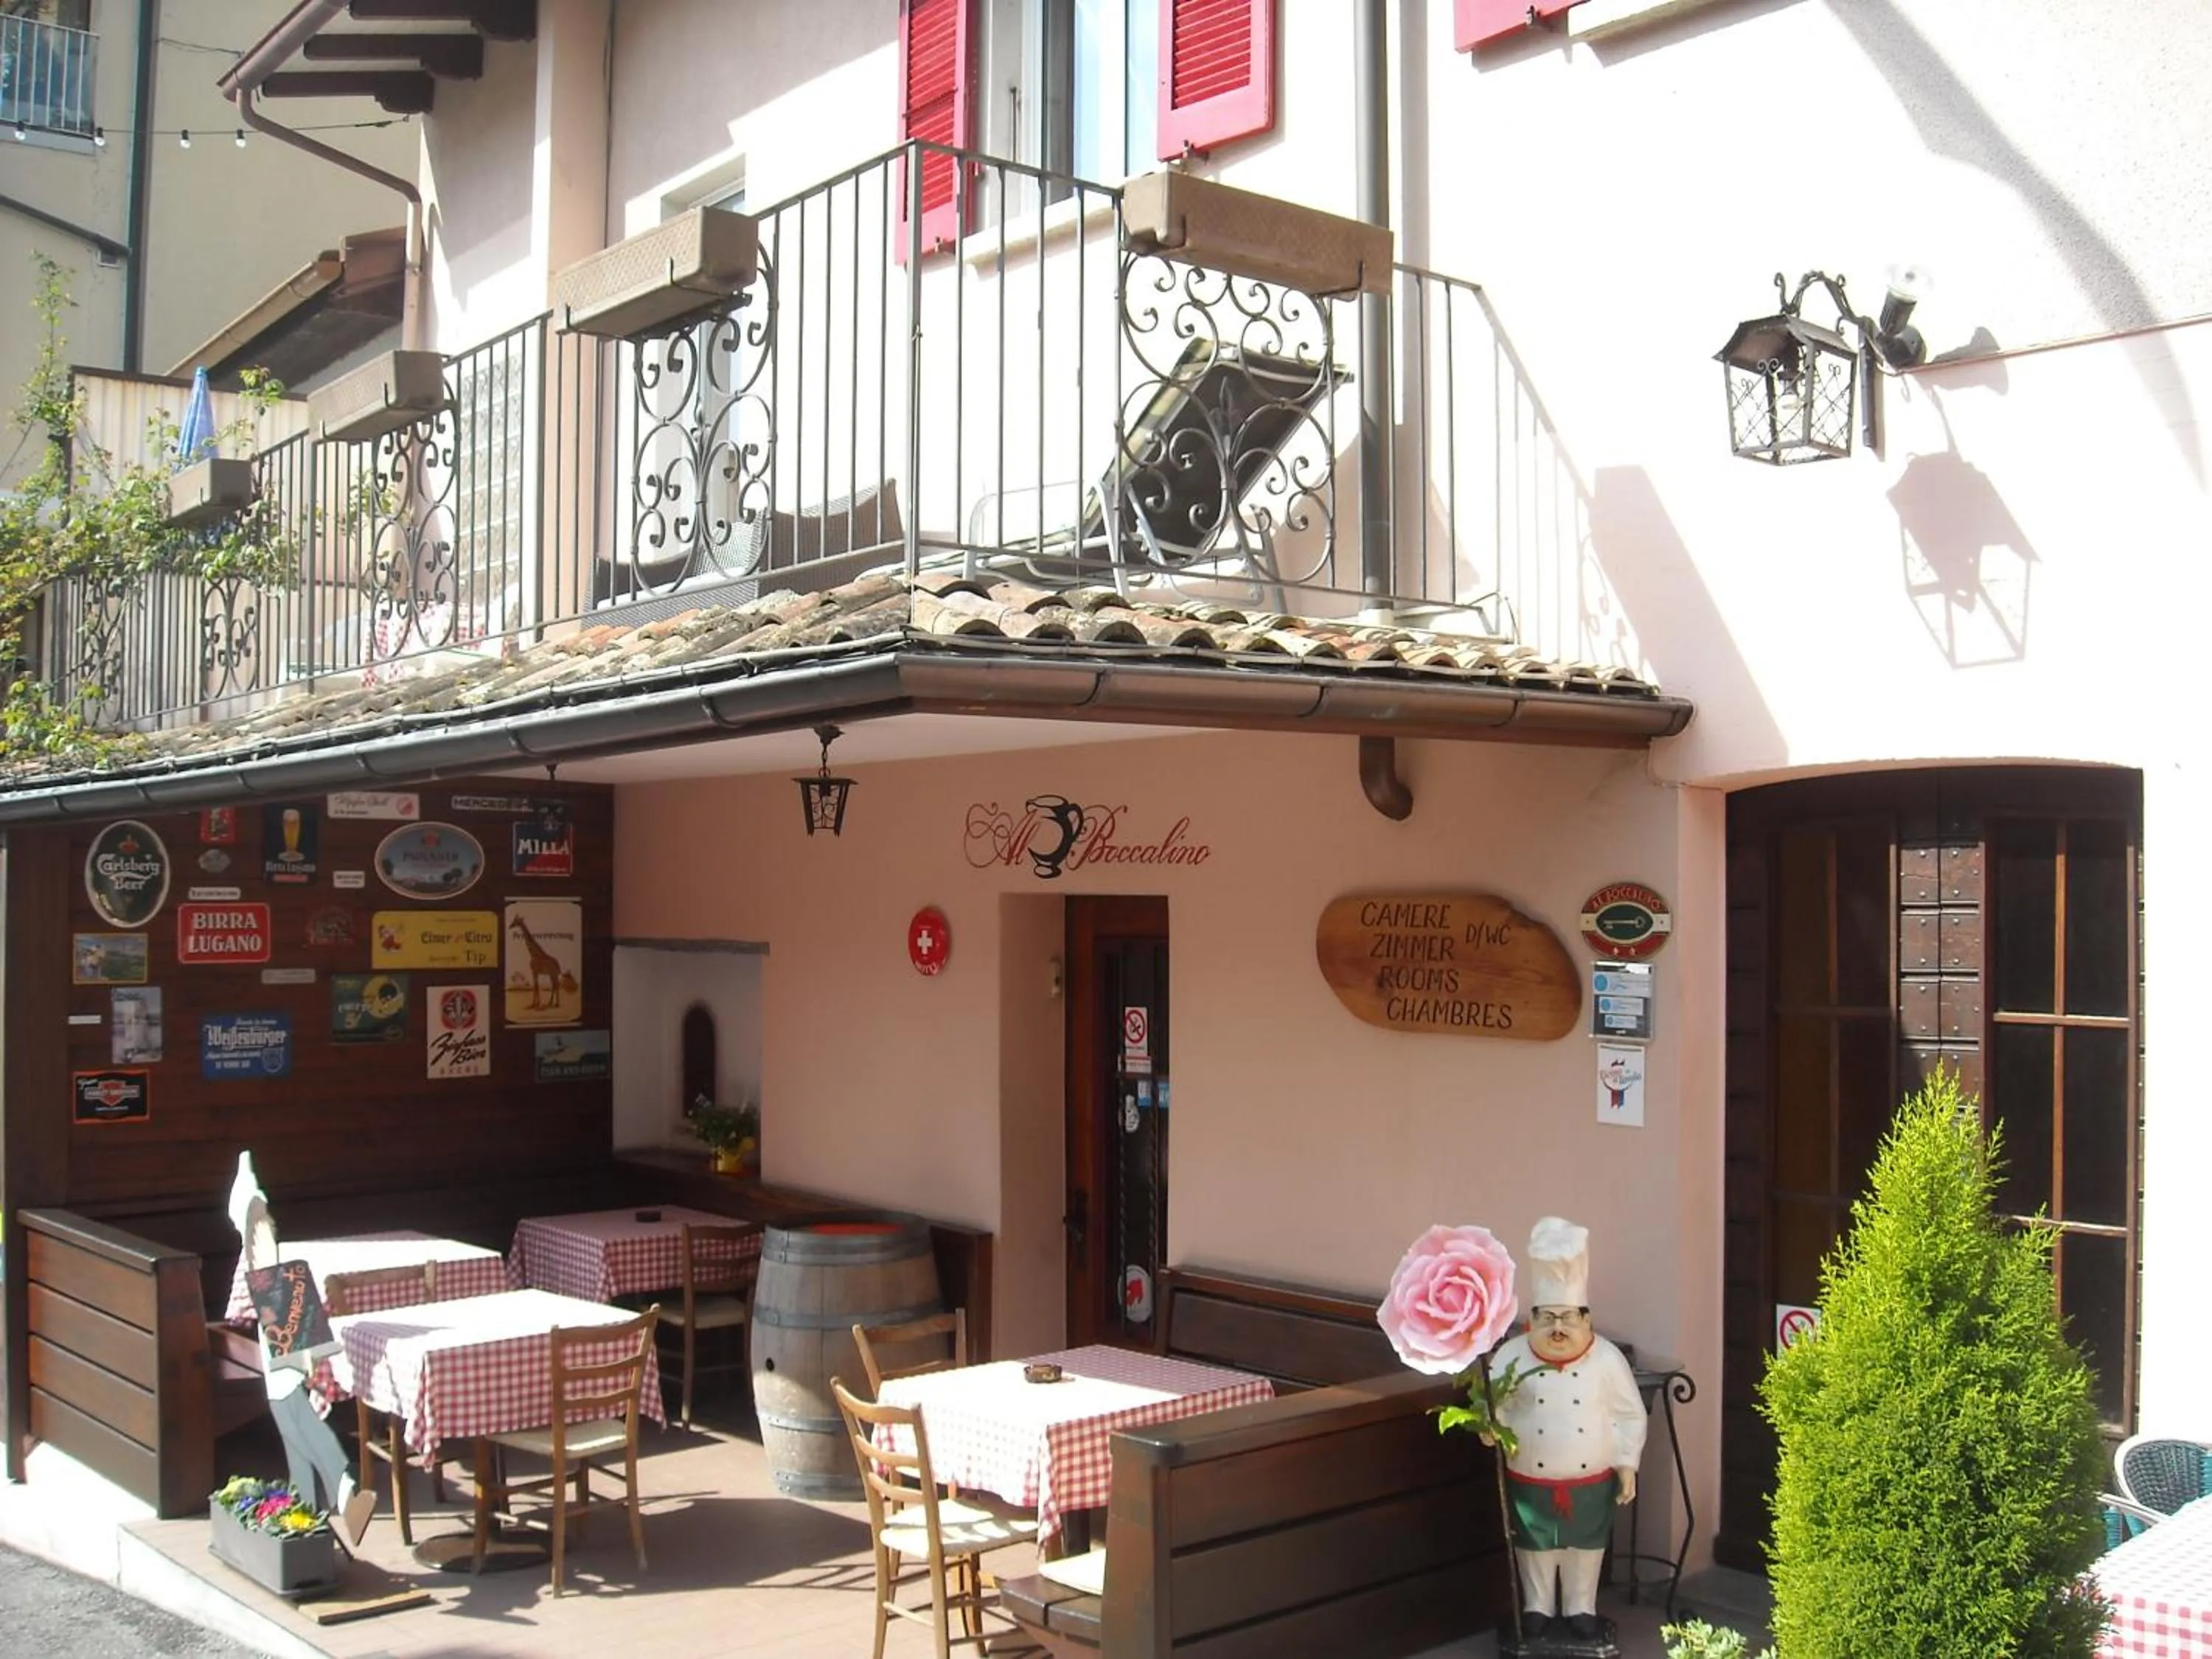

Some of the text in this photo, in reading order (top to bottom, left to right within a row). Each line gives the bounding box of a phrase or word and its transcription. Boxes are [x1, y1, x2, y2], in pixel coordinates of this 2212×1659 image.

[1066, 804, 1211, 871] Boccalino
[97, 852, 161, 877] Carlsberg
[114, 877, 147, 891] Beer
[192, 911, 258, 930] BIRRA
[1360, 901, 1452, 930] CAMERE
[187, 935, 262, 953] LUGANO
[1370, 933, 1455, 961] ZIMMER
[1377, 965, 1460, 993] ROOMS
[1386, 997, 1513, 1029] CHAMBRES
